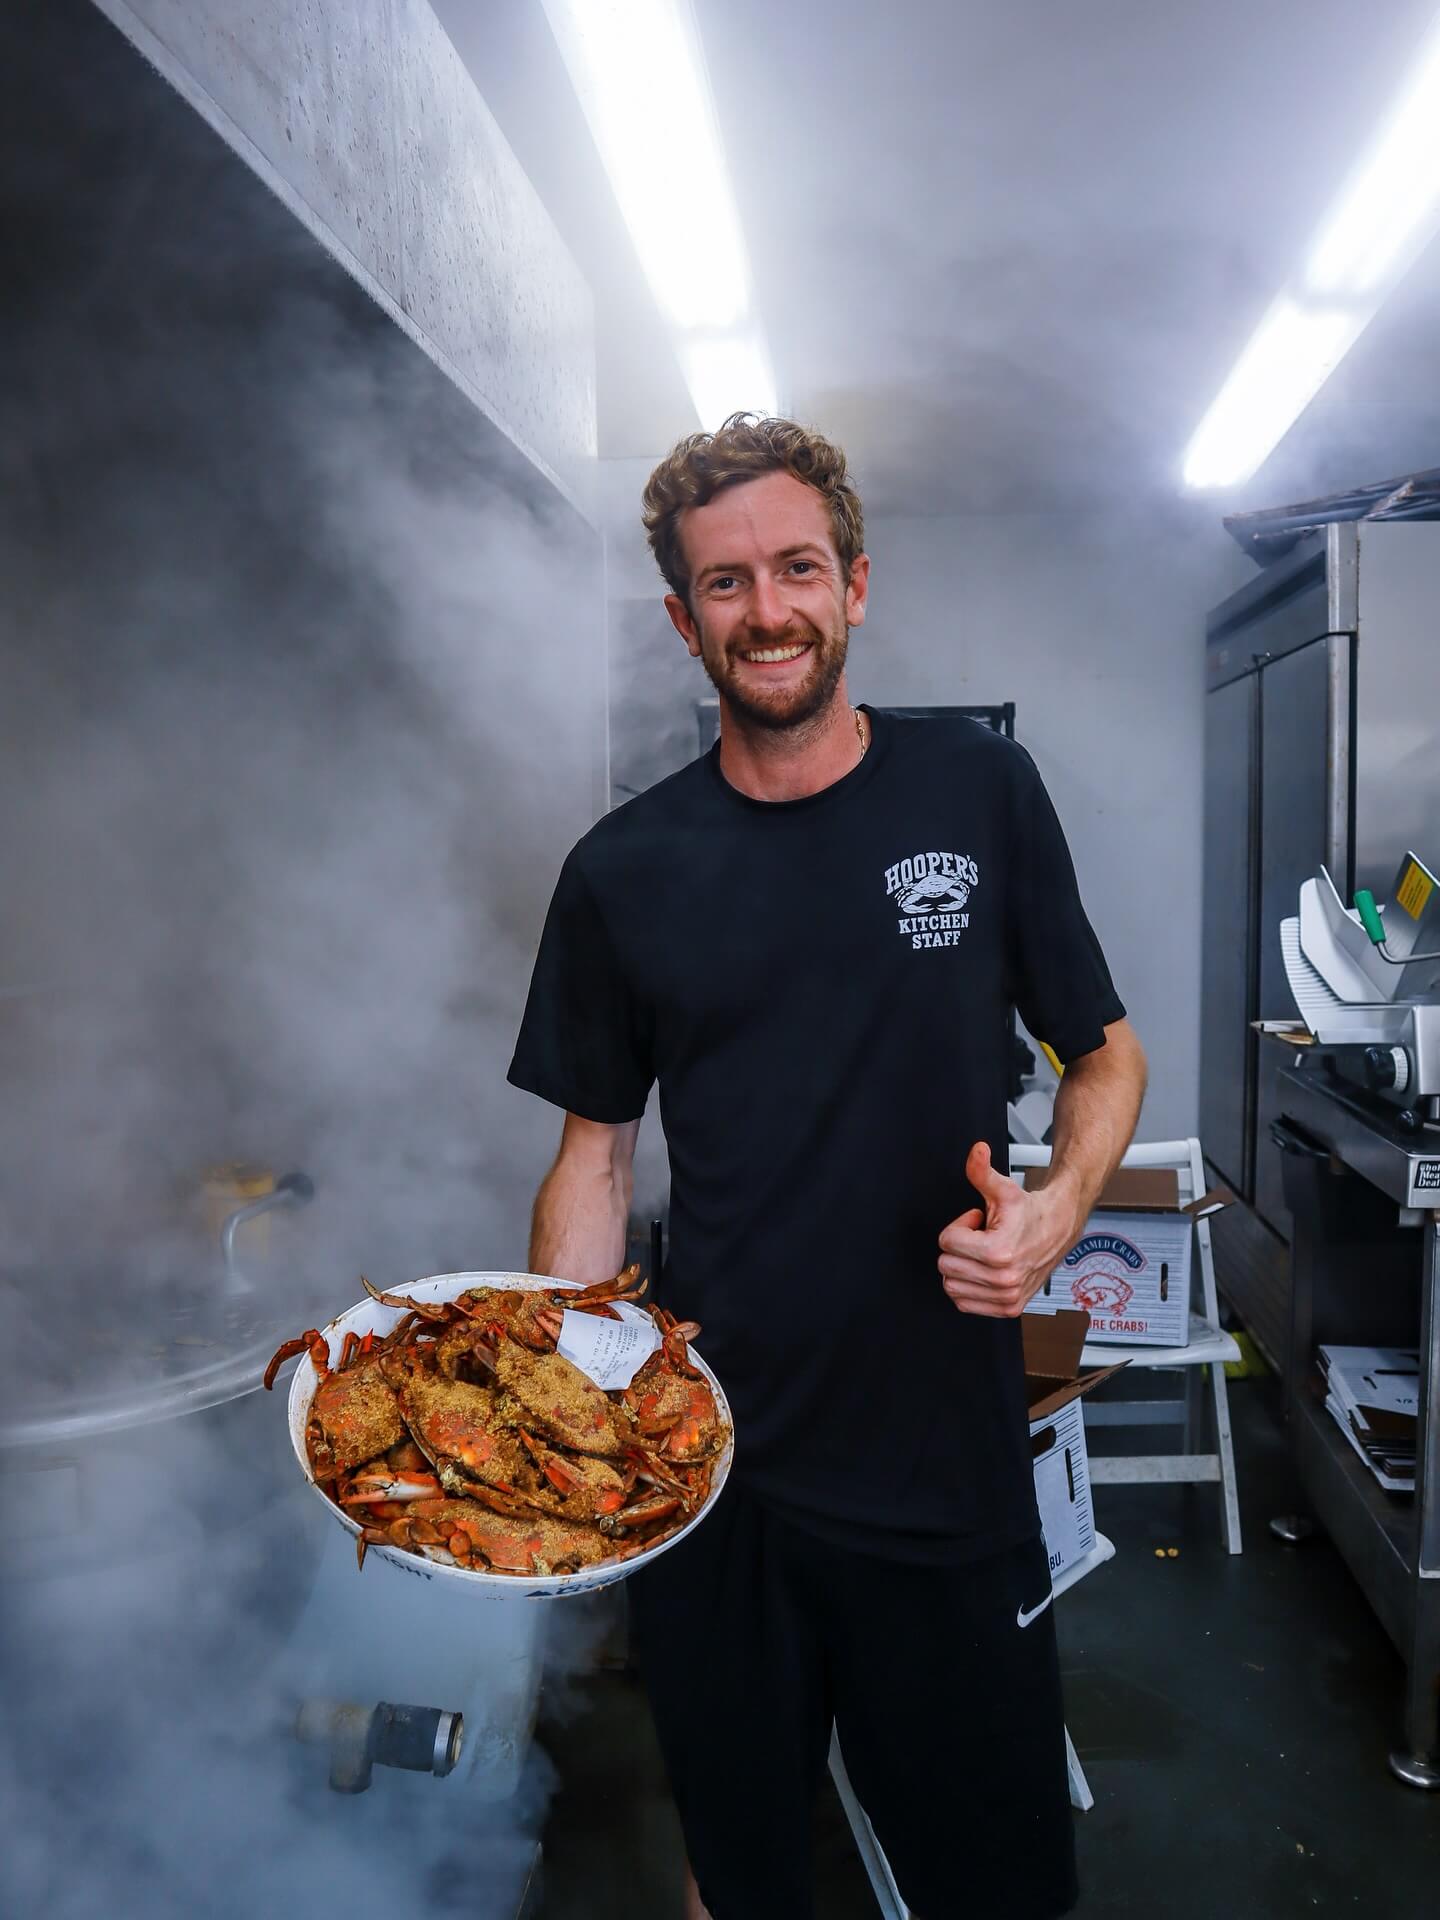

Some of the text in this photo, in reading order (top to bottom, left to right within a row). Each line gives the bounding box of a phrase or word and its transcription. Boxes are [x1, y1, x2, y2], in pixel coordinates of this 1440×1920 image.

[884, 852, 979, 895] HOOPER'S
[898, 913, 970, 934] KITCHEN
[912, 930, 961, 950] STAFF
[1066, 1239, 1140, 1267] STEAMED CRABS
[1088, 1319, 1148, 1332] RE CRABS!
